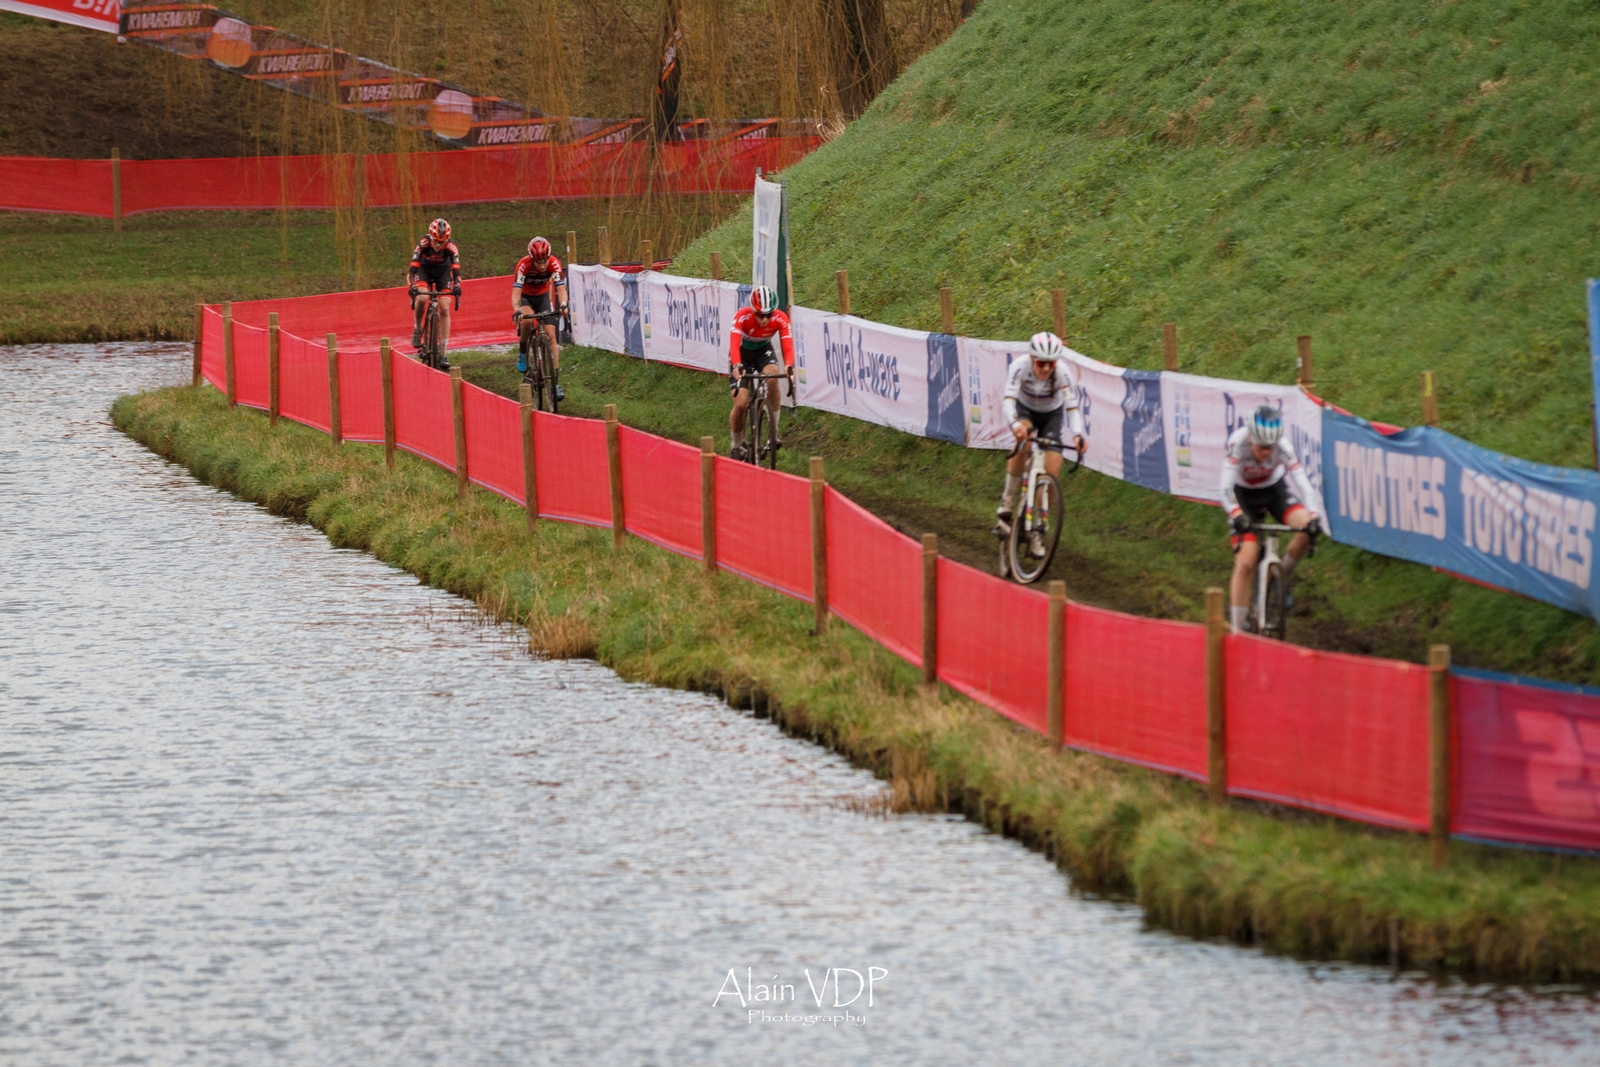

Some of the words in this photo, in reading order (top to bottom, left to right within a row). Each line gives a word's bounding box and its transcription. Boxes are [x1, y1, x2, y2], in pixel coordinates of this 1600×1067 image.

[664, 283, 692, 354] Royal
[824, 322, 857, 405] Royal
[857, 329, 901, 401] A-ware
[1335, 440, 1387, 529] TOYO
[1386, 451, 1447, 540] TIRES
